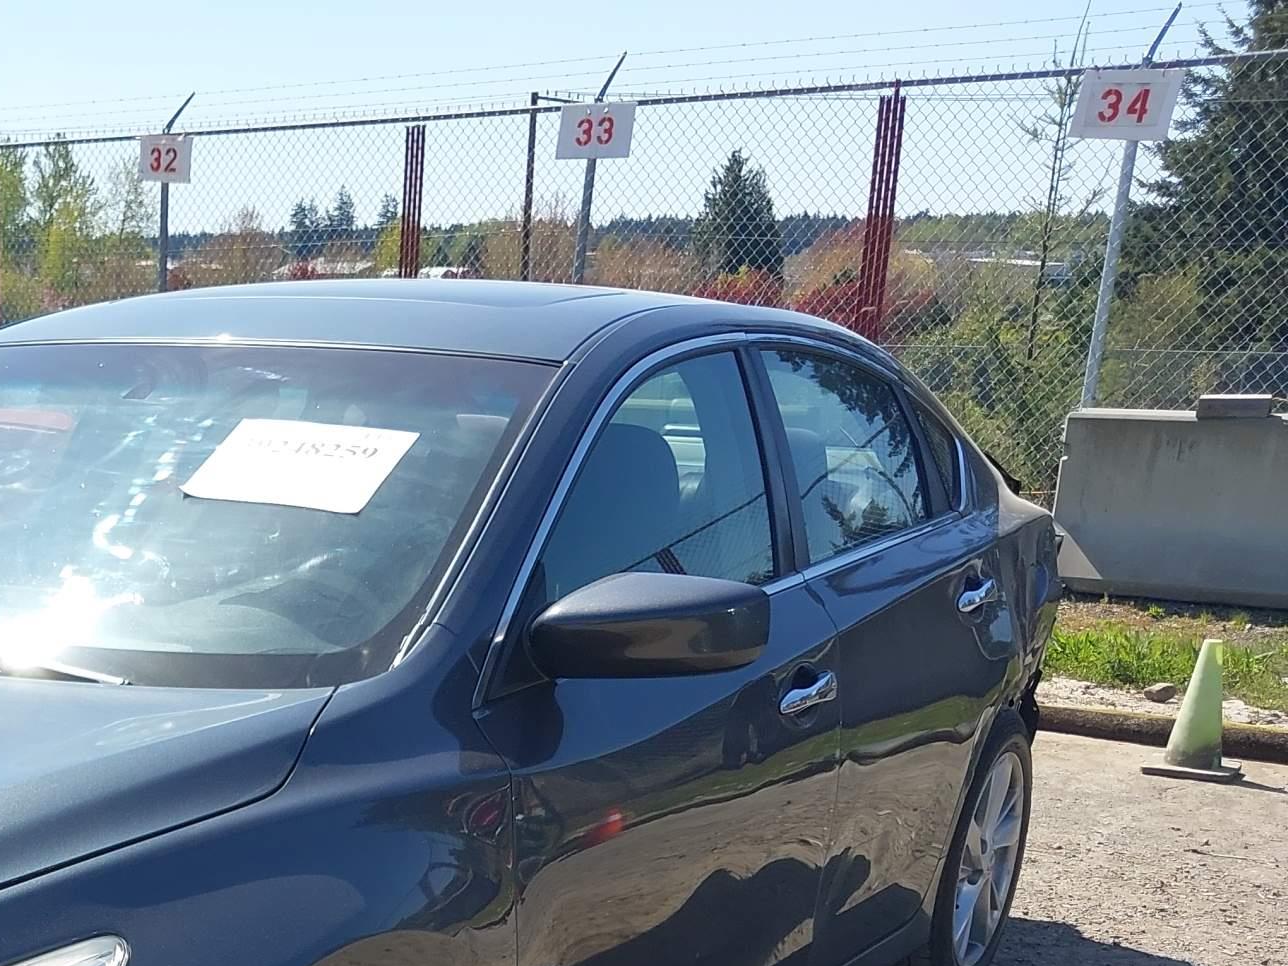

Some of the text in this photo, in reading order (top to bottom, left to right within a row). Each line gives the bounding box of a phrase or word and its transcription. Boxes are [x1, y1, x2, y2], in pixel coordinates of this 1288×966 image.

[1098, 87, 1151, 124] 34
[576, 116, 615, 147] 33
[149, 147, 178, 173] 32
